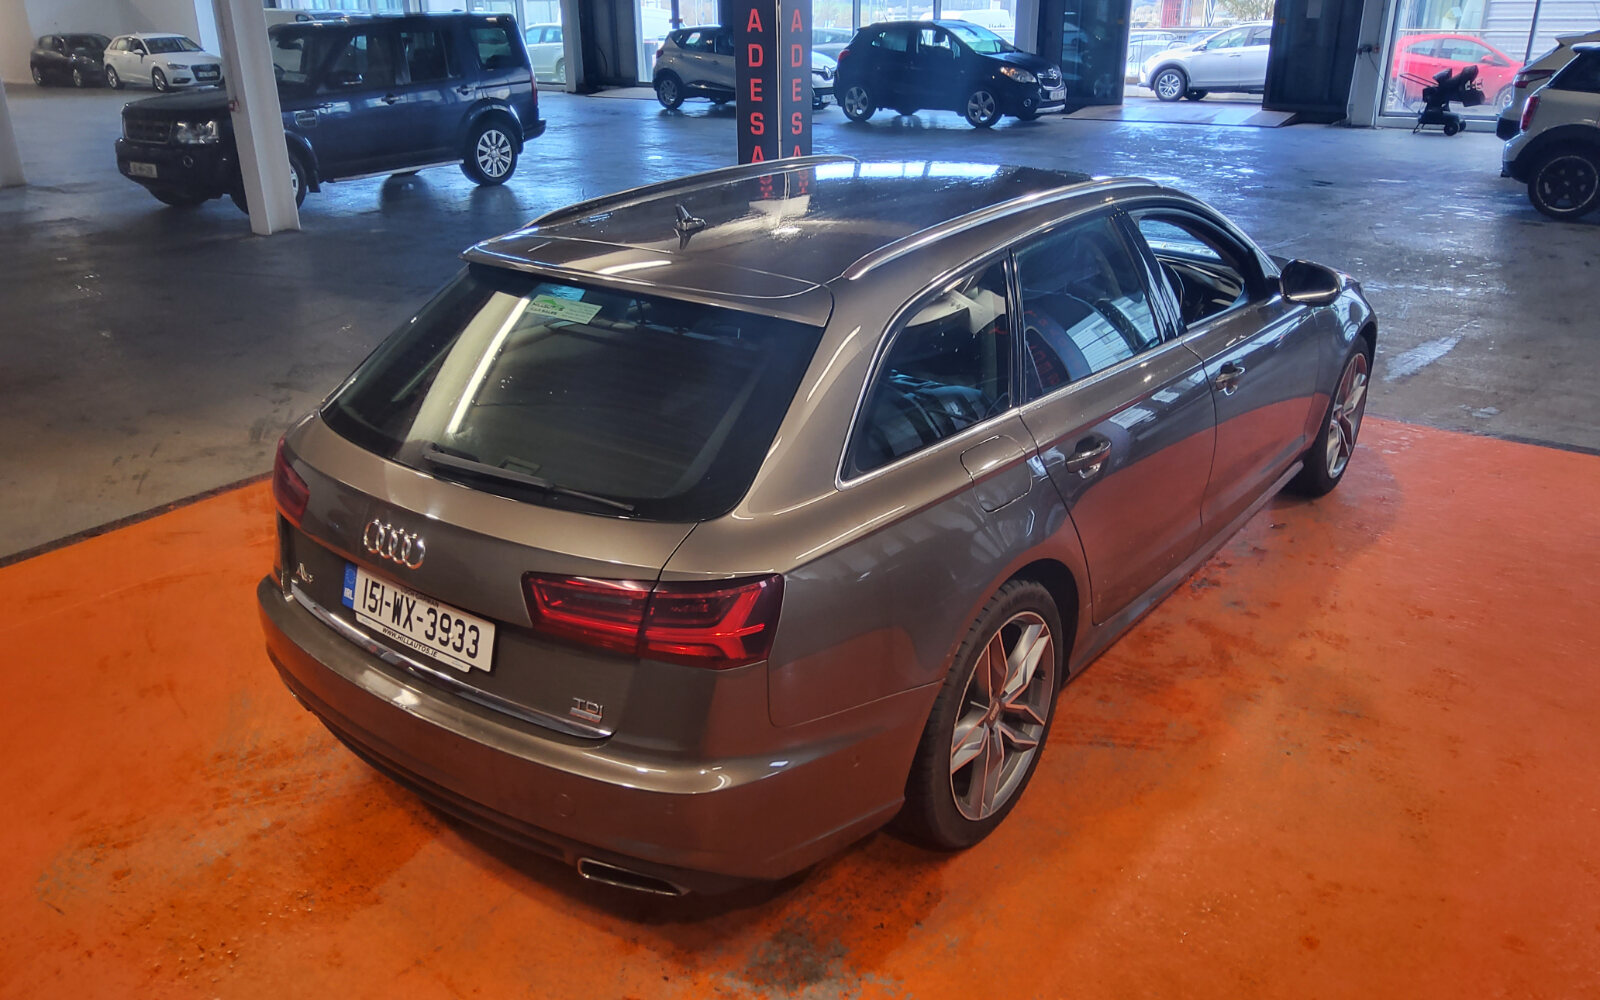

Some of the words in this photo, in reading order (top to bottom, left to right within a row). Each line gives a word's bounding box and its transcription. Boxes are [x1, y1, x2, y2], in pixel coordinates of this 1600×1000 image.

[746, 8, 765, 163] ADESA
[362, 577, 480, 659] 151-WX-3933
[382, 627, 439, 658] WWW.HILLAUTOS.IE
[572, 697, 603, 716] TDI
